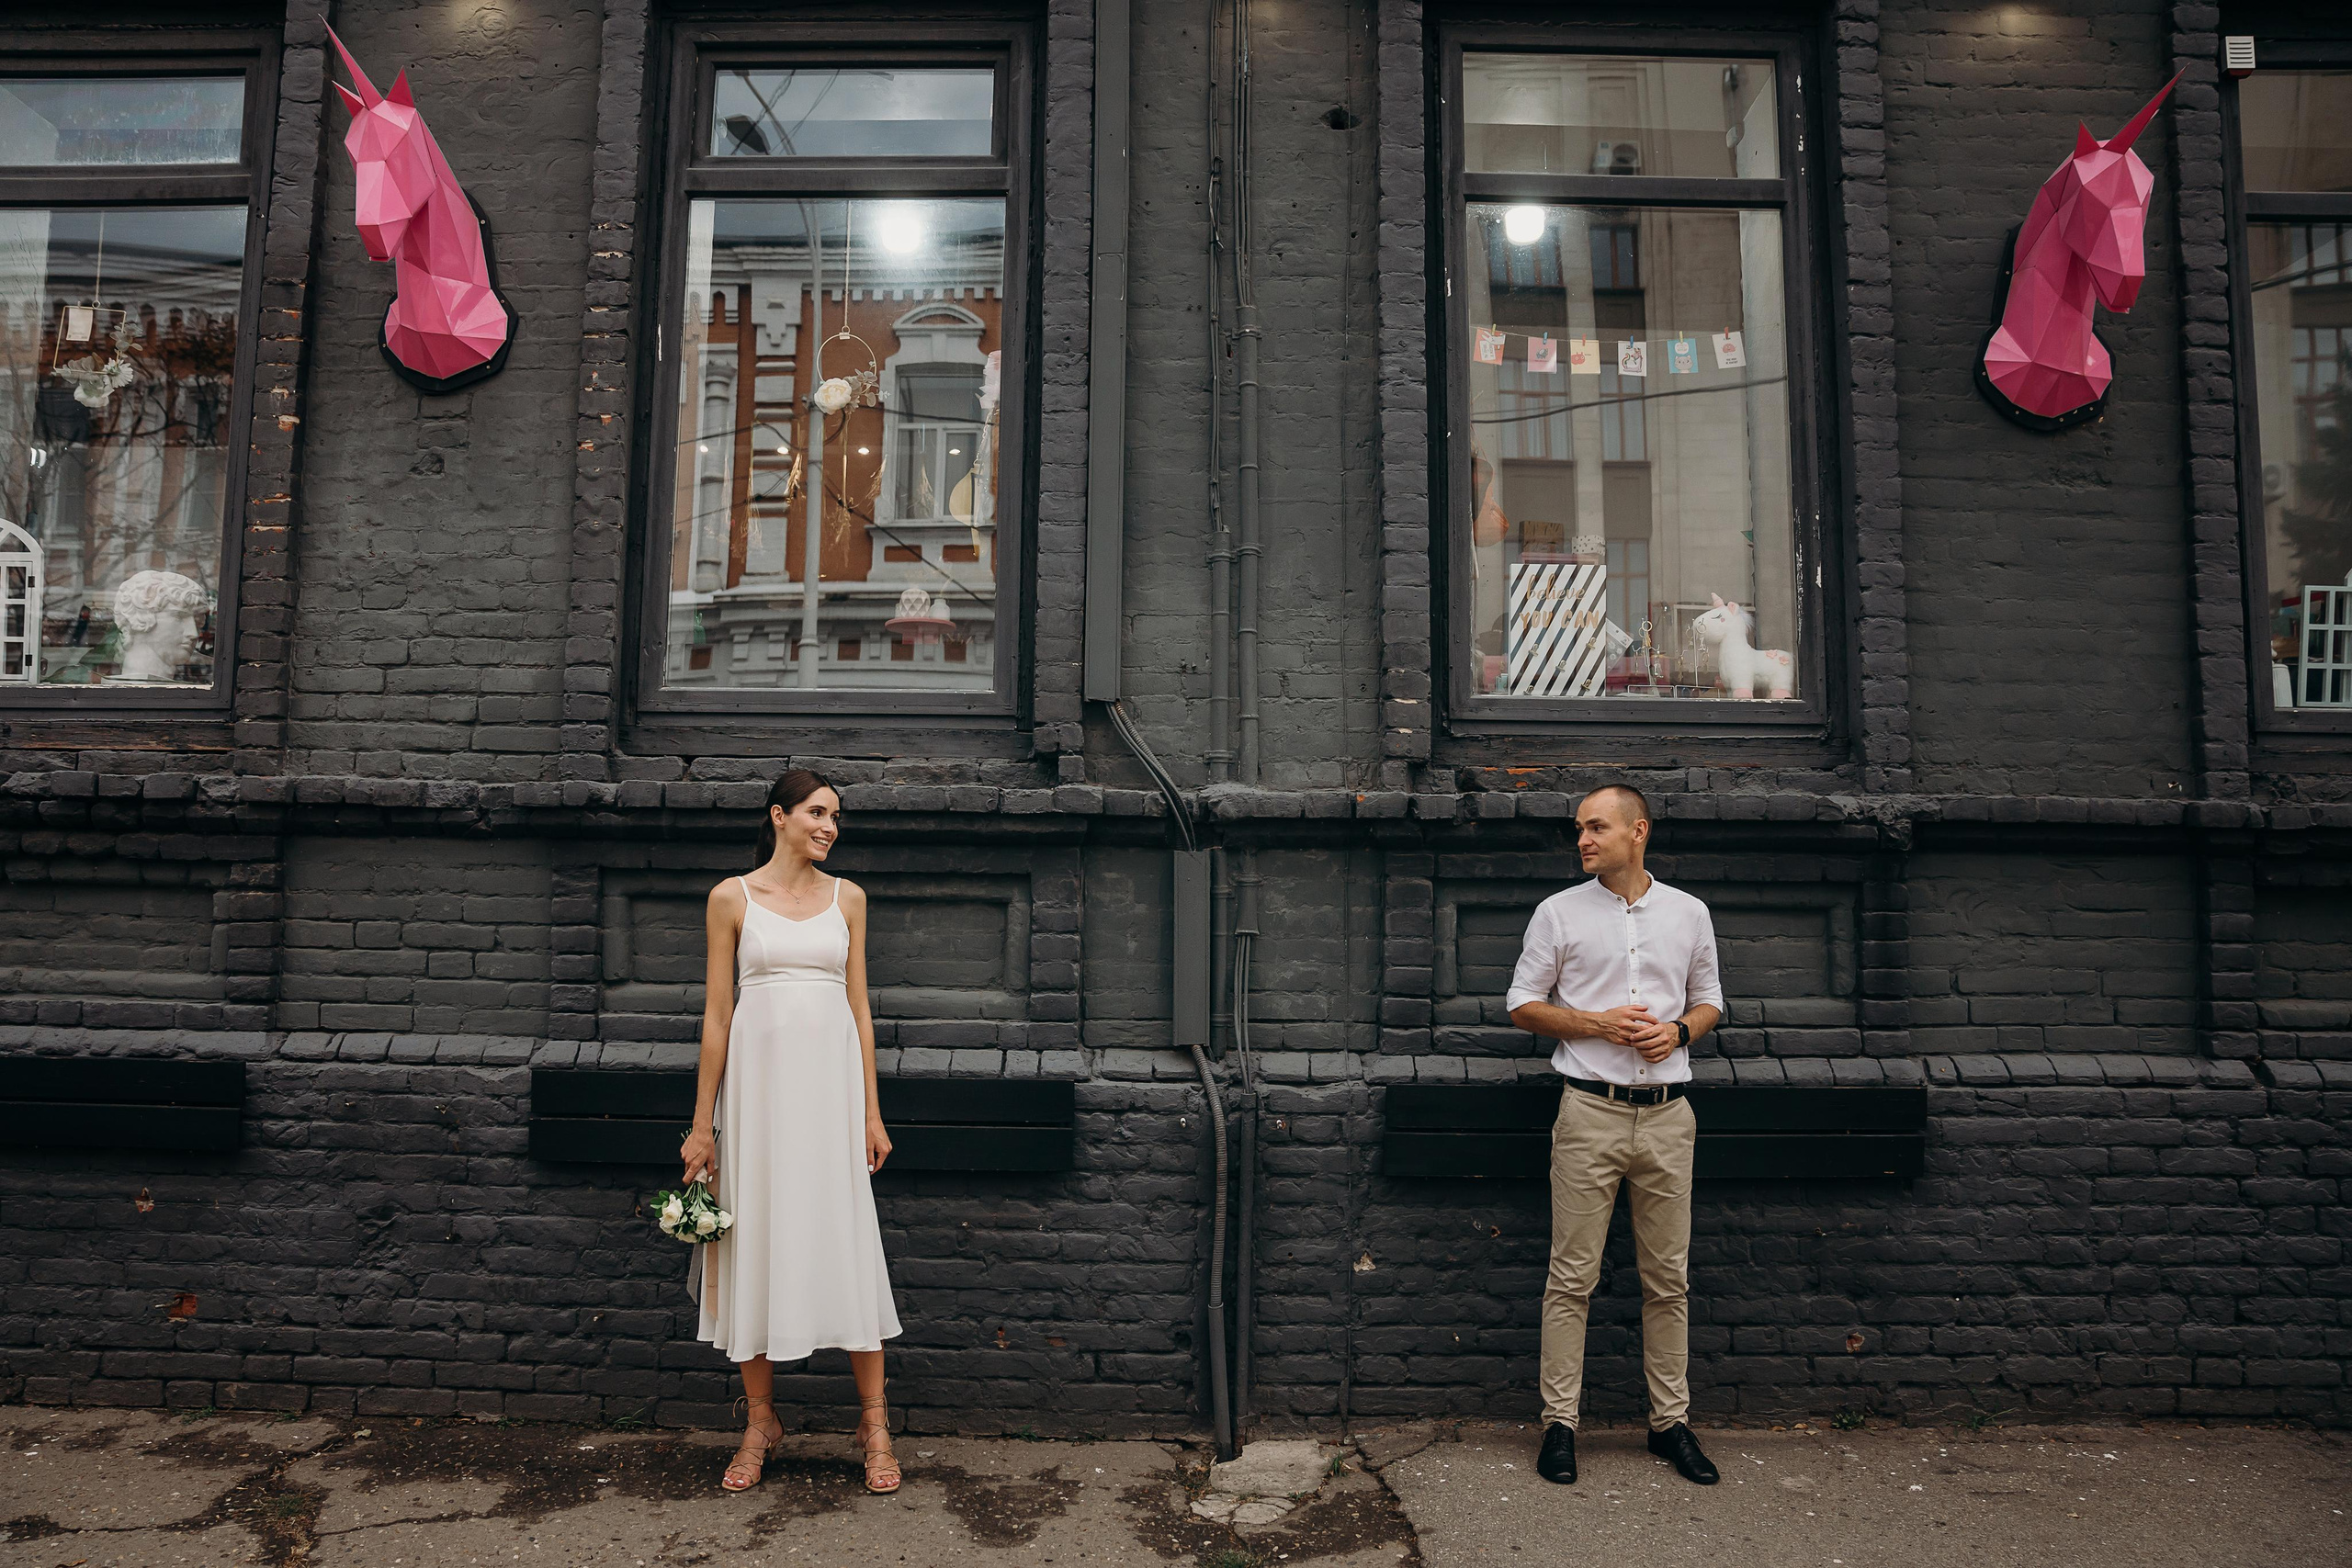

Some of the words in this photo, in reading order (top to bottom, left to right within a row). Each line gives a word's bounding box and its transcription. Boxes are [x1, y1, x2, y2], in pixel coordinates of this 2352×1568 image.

[1526, 573, 1585, 600] believe
[1520, 610, 1553, 628] YOU
[1561, 609, 1599, 628] CAN
